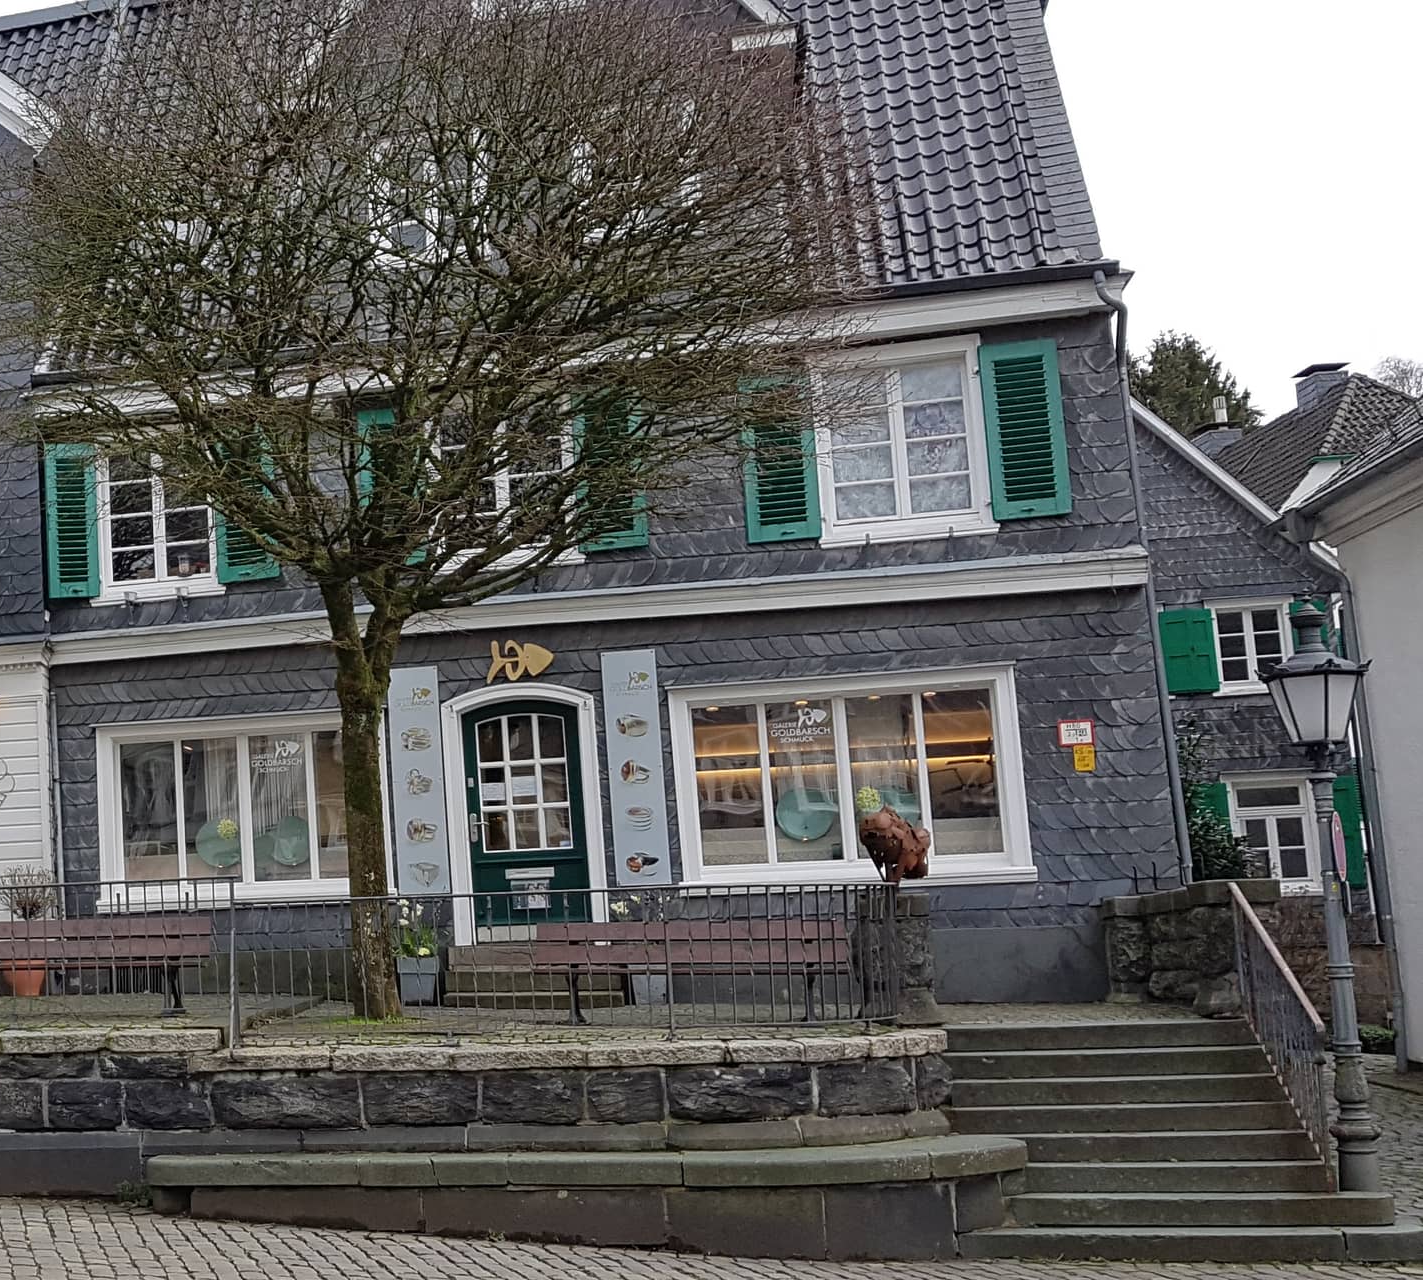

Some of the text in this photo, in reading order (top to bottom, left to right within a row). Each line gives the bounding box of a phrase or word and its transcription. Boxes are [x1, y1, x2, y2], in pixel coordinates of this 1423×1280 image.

[771, 726, 831, 737] GOLDBARSCH
[780, 735, 814, 743] SCHMUCK
[251, 758, 303, 767] GOLDBARSCH
